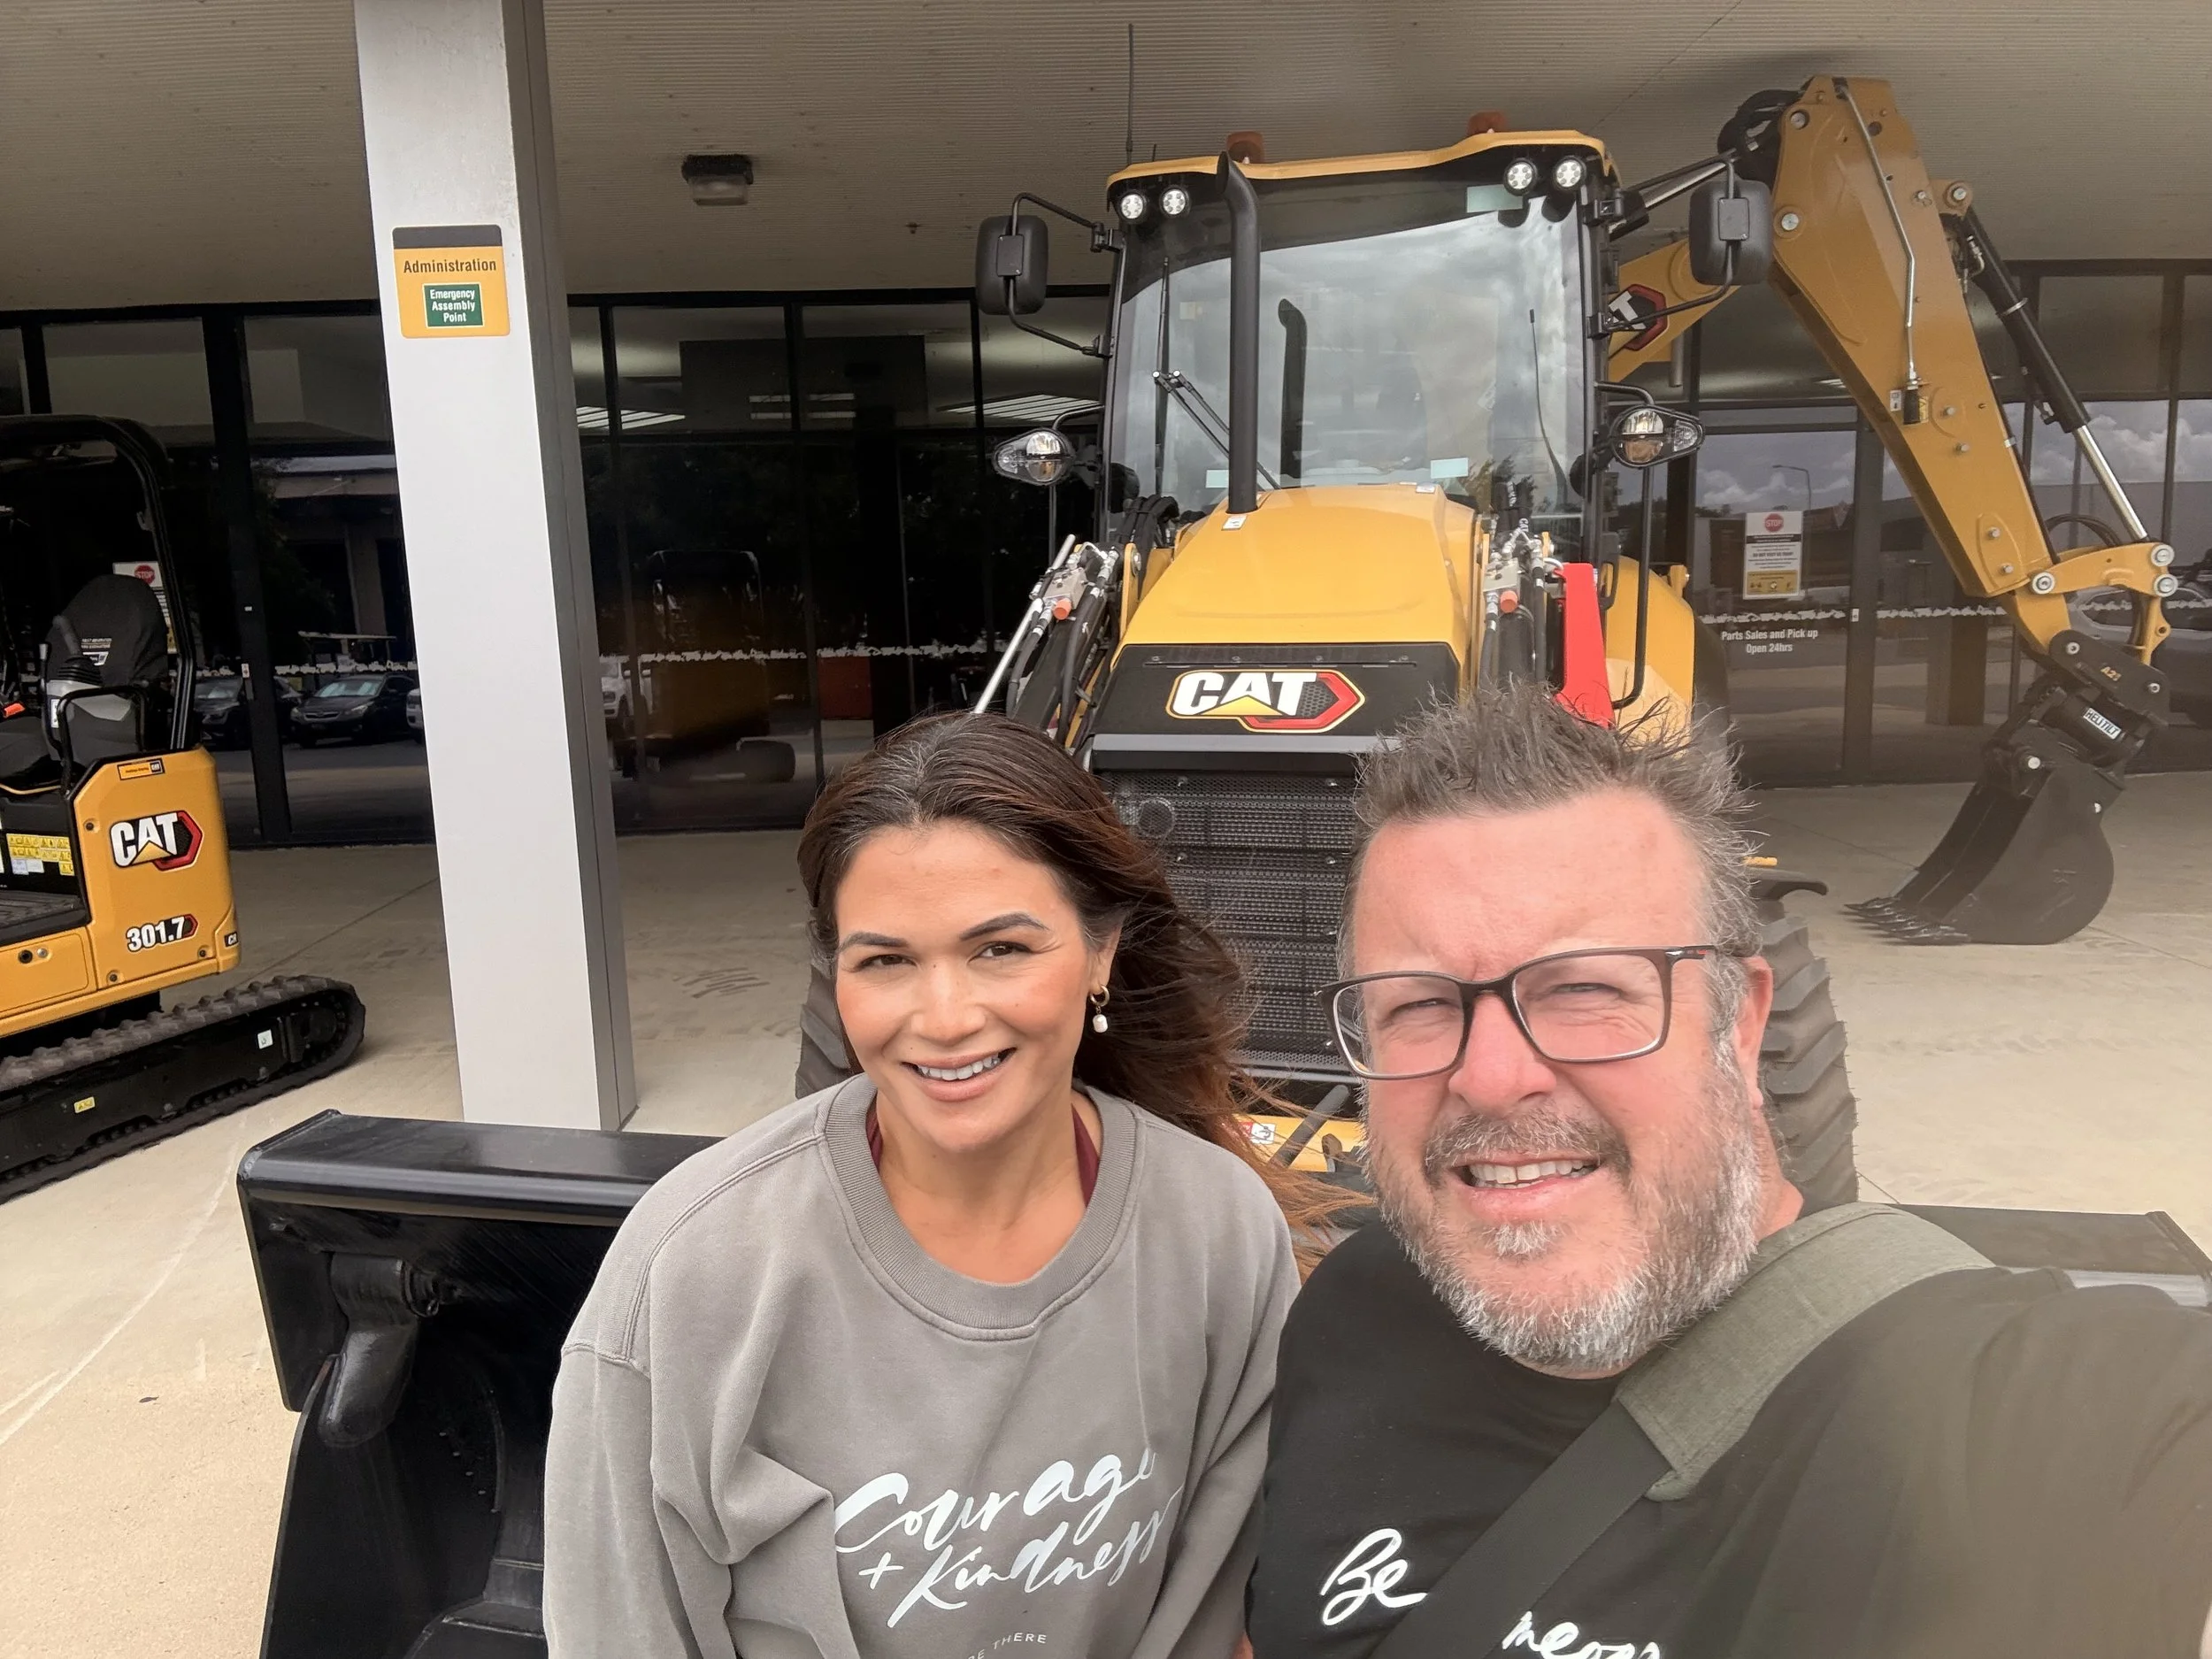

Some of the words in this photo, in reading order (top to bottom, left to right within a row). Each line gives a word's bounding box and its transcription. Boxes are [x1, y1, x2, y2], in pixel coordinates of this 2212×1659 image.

[403, 258, 496, 273] Administration
[429, 288, 475, 300] Emergency
[432, 300, 476, 311] Assembly
[443, 312, 467, 323] Point
[1721, 631, 1743, 641] Parts
[1745, 630, 1768, 640] Sales
[1770, 629, 1786, 639] and
[1787, 628, 1806, 638] Pick
[1807, 629, 1818, 640] up
[1746, 643, 1767, 655] Open
[1769, 642, 1793, 652] 24hrs
[1172, 672, 1317, 716] CAT
[110, 812, 178, 867] CAT
[127, 916, 184, 952] 301.7
[887, 1484, 1184, 1628] Kindness
[1319, 1528, 1428, 1626] Be
[991, 1632, 1048, 1650] THERE
